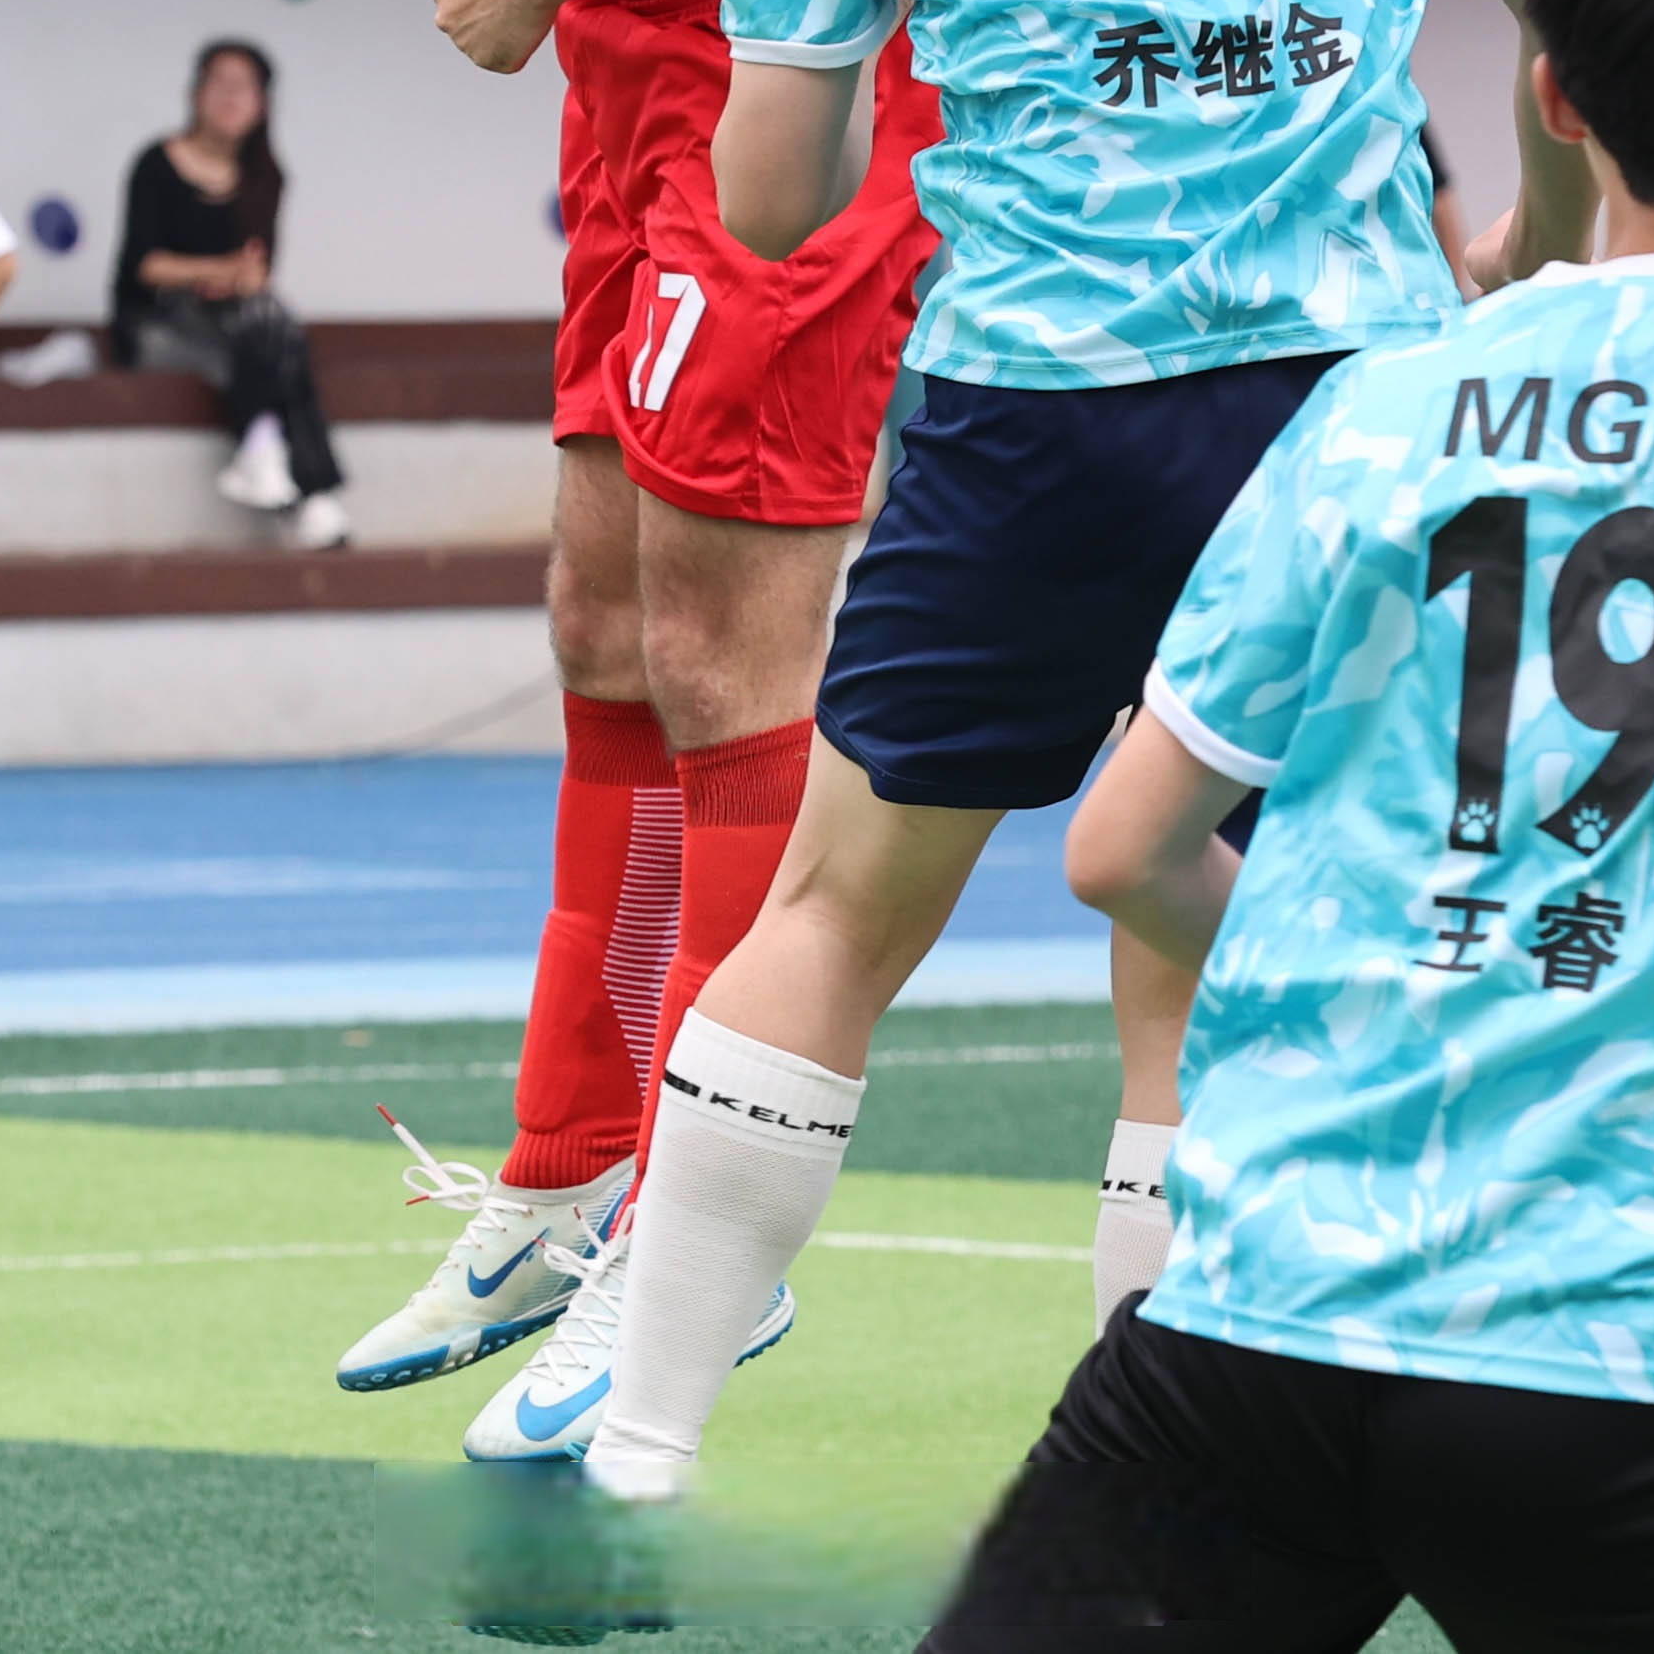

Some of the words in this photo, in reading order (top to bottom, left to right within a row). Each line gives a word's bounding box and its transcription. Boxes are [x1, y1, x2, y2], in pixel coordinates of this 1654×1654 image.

[1093, 3, 1354, 108] 乔继金
[1414, 892, 1627, 994] 王睿
[710, 1092, 855, 1138] KELME
